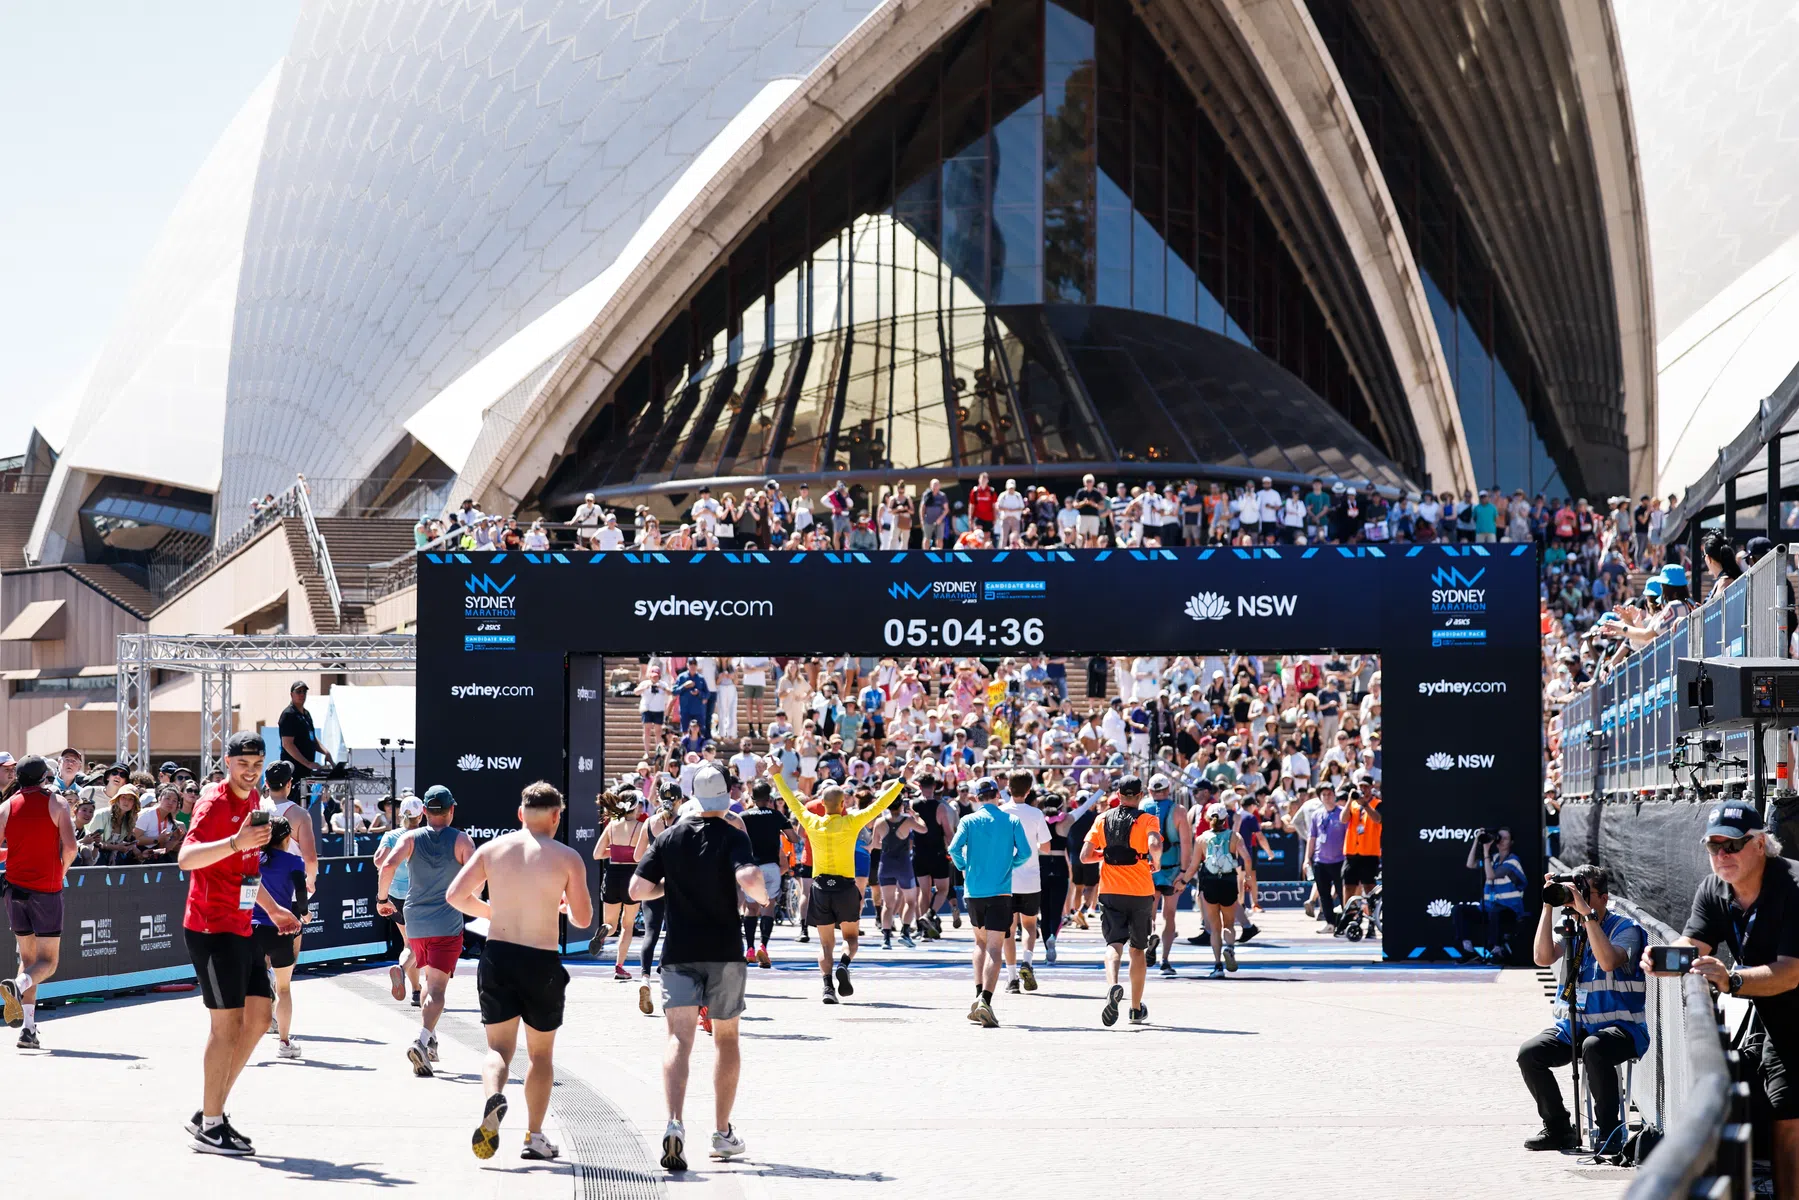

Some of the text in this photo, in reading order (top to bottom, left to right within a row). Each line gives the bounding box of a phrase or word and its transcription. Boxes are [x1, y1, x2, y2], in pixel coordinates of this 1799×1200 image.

[933, 581, 977, 593] SYDNEY
[465, 596, 516, 609] SYDNEY
[1432, 589, 1486, 603] SYDNEY
[634, 595, 773, 620] sydney.com
[1237, 595, 1298, 617] NSW
[1432, 603, 1487, 611] MARATHON
[465, 609, 516, 617] MARATHON
[884, 618, 1045, 647] 05:04:36
[451, 683, 534, 699] sydney.com
[1418, 679, 1507, 696] sydney.com
[487, 757, 522, 770] NSW
[1457, 755, 1495, 768] NSW
[97, 929, 111, 938] WORLD
